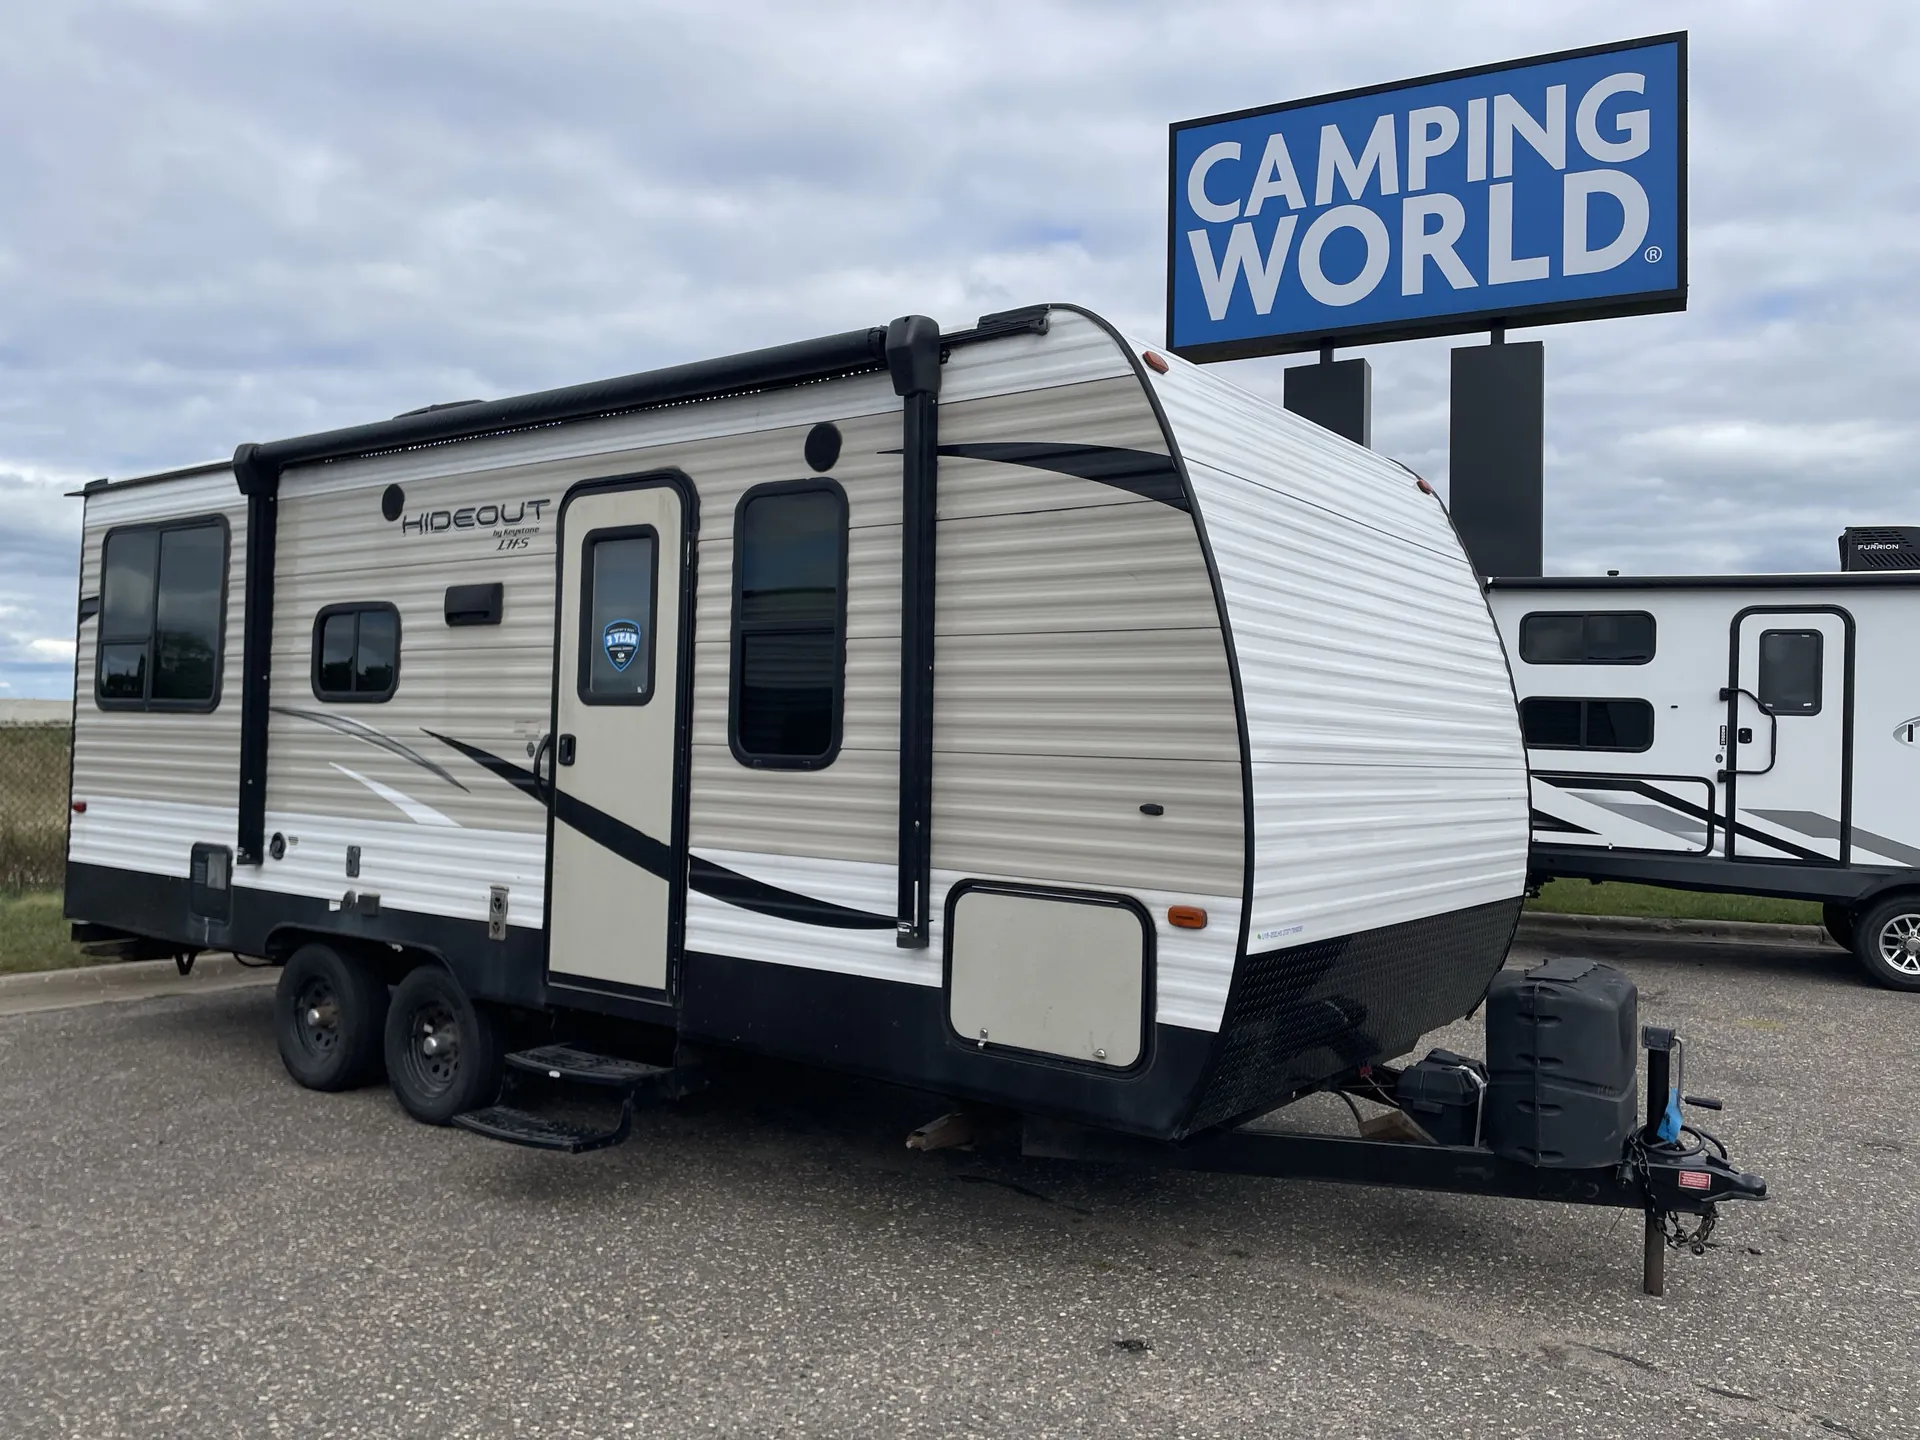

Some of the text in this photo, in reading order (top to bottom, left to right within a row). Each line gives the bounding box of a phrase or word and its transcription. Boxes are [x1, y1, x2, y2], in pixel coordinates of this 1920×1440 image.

[1187, 72, 1650, 223] CAMPING
[1187, 168, 1650, 321] WORLD
[402, 499, 551, 535] HIDEOUT
[1857, 543, 1899, 551] FURRION
[614, 632, 638, 646] YEAR
